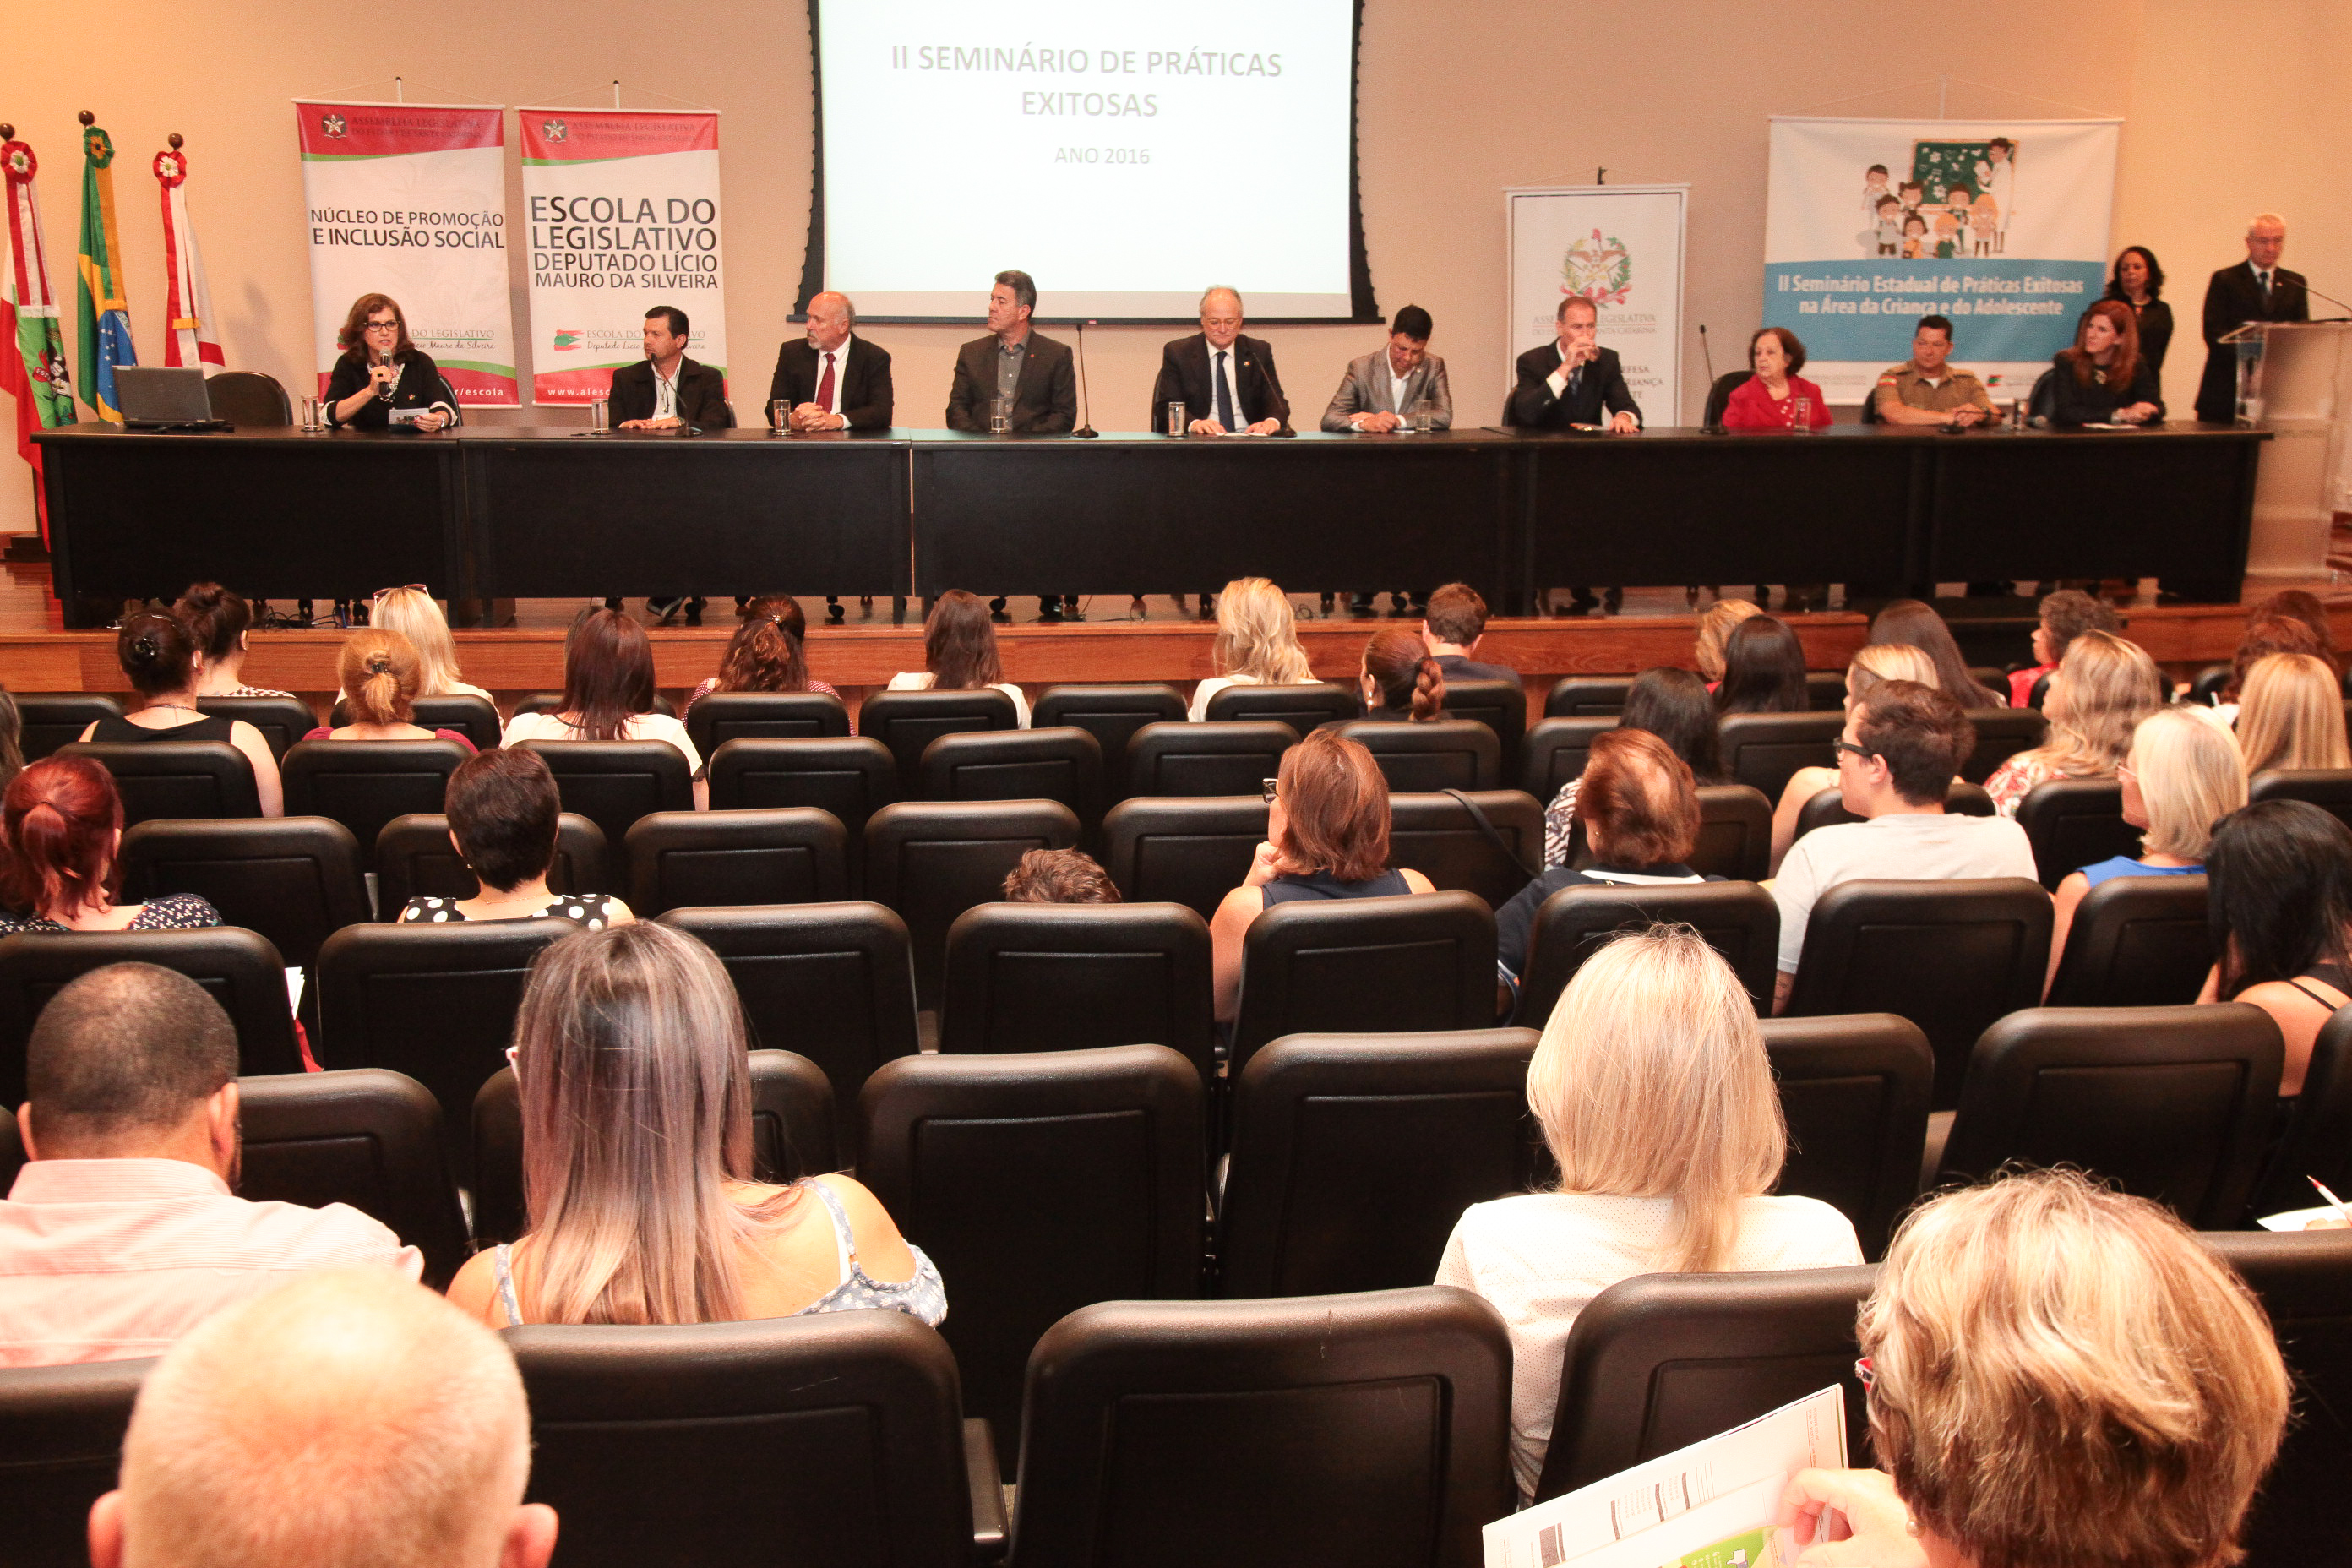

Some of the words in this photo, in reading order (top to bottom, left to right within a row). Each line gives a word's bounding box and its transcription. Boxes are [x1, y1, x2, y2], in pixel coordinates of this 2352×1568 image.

[891, 45, 908, 70] II
[917, 42, 1089, 74] SEMINÁRIO
[1099, 49, 1136, 74] DE
[1147, 46, 1282, 77] PRÁTICAS
[1021, 90, 1158, 117] EXITOSAS
[1054, 147, 1099, 164] ANO
[1103, 148, 1150, 165] 2016
[310, 207, 378, 224] NÚCLEO
[383, 211, 404, 225] DE
[409, 211, 504, 229] PROMOÇÃO
[531, 195, 657, 224] ESCOLA
[667, 198, 716, 225] DO
[313, 227, 325, 245] E
[329, 226, 430, 248] INCLUSÃO
[434, 231, 505, 248] SOCIAL
[532, 226, 716, 252] LEGISLATIVO
[534, 252, 656, 272] DEPUTADO
[662, 250, 718, 272] LÍCIO
[535, 272, 605, 288] MAURO
[610, 273, 636, 288] DA
[641, 273, 718, 289] SILVEIRA
[1778, 274, 1790, 292] II
[1792, 274, 1870, 293] Seminário
[1873, 275, 1939, 293] Estadual
[1940, 275, 1960, 294] de
[1962, 275, 2021, 294] Práticas
[2023, 275, 2084, 294] Exitosas
[1799, 300, 1819, 314] na
[1821, 294, 1858, 314] Área
[1859, 297, 1880, 315] da
[1881, 297, 1937, 318] Criança
[1939, 302, 1951, 315] e
[1952, 298, 1972, 315] do
[1973, 298, 2064, 316] Adolescente
[411, 329, 427, 338] DO
[431, 329, 495, 339] LEGISLATIVO
[586, 329, 623, 339] ESCOLA
[626, 330, 641, 339] DO
[455, 340, 464, 349] da
[466, 340, 496, 350] Silveira
[455, 387, 504, 396] r/escola
[547, 387, 611, 396] www.alesc
